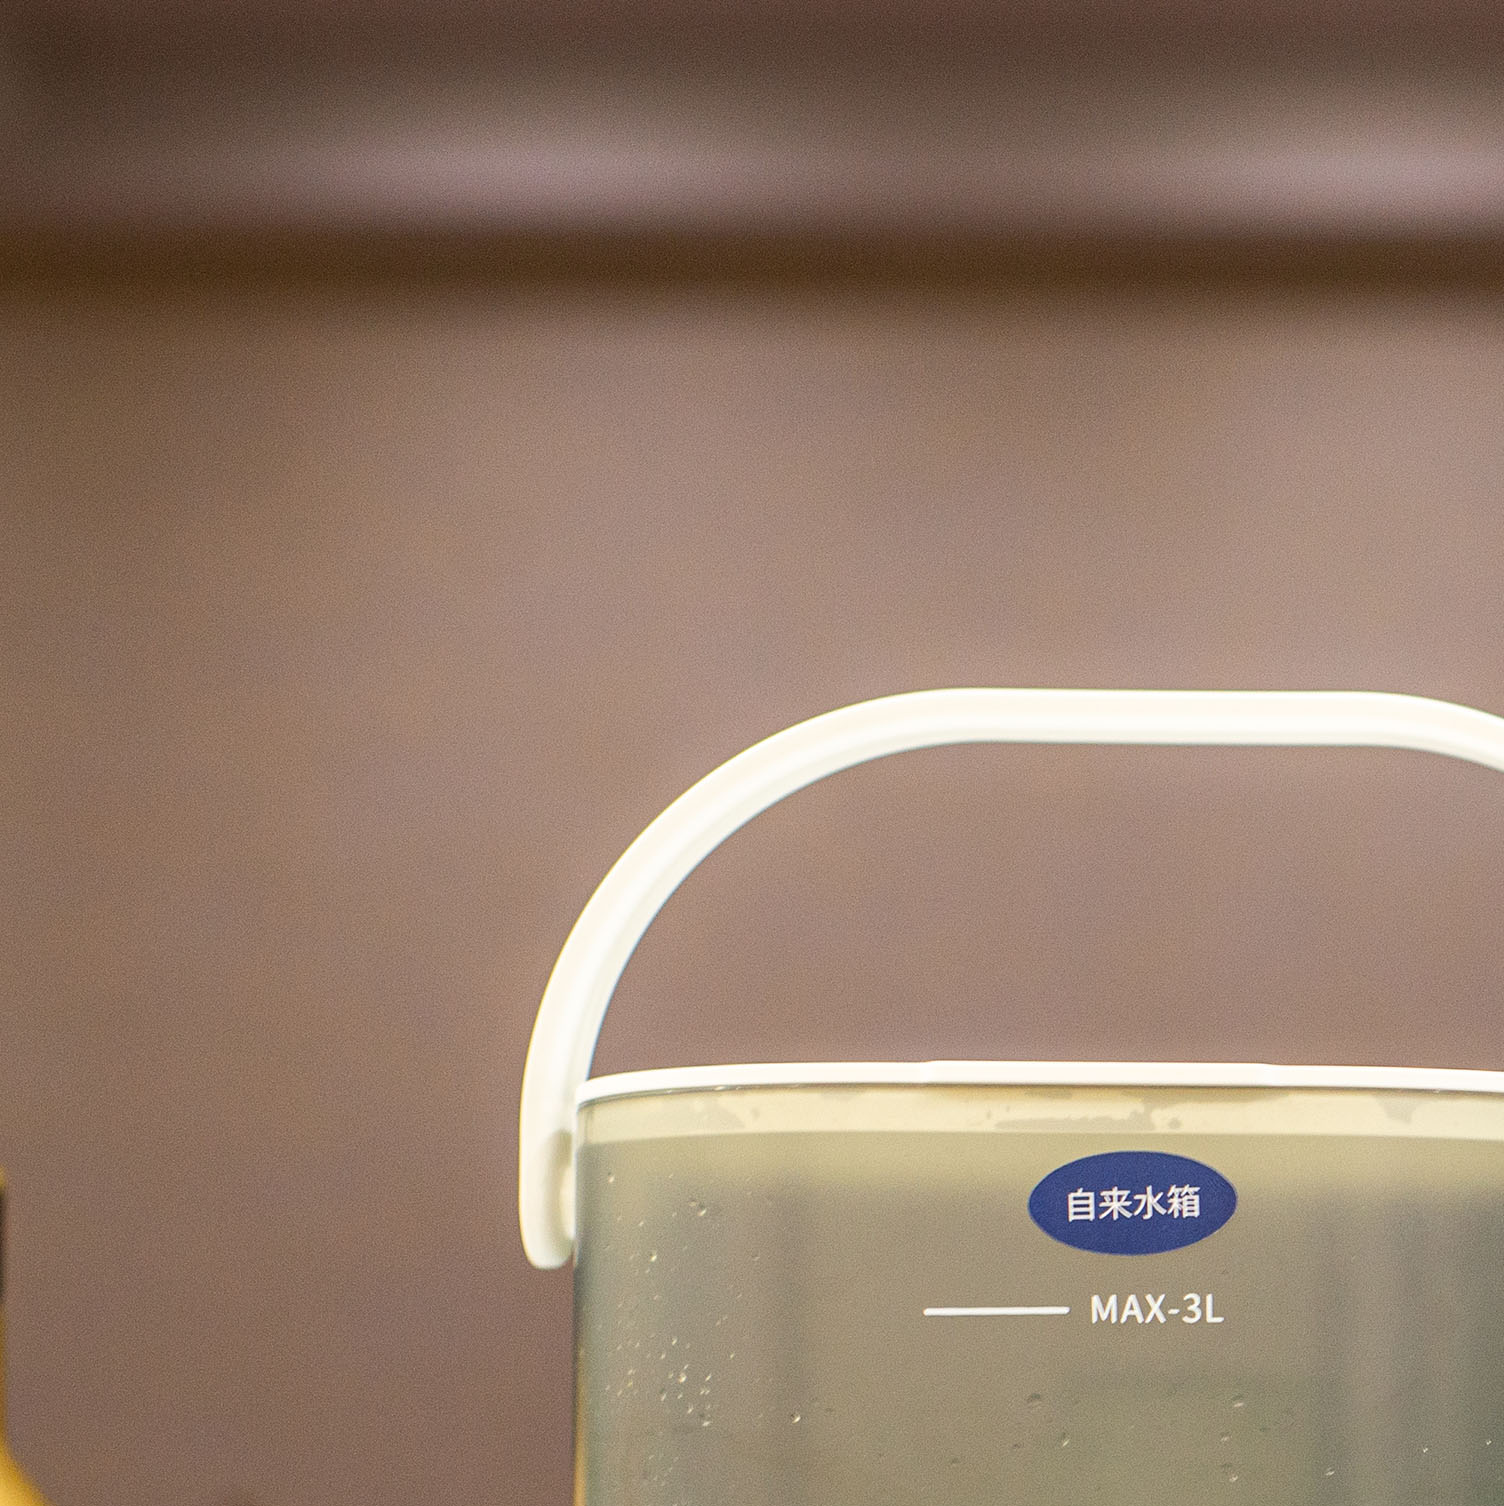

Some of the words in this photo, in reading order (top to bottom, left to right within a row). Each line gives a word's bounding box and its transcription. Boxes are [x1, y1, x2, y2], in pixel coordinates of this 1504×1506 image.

[1067, 1184, 1201, 1221] 自来水箱
[1090, 1293, 1225, 1324] MAX-3L
